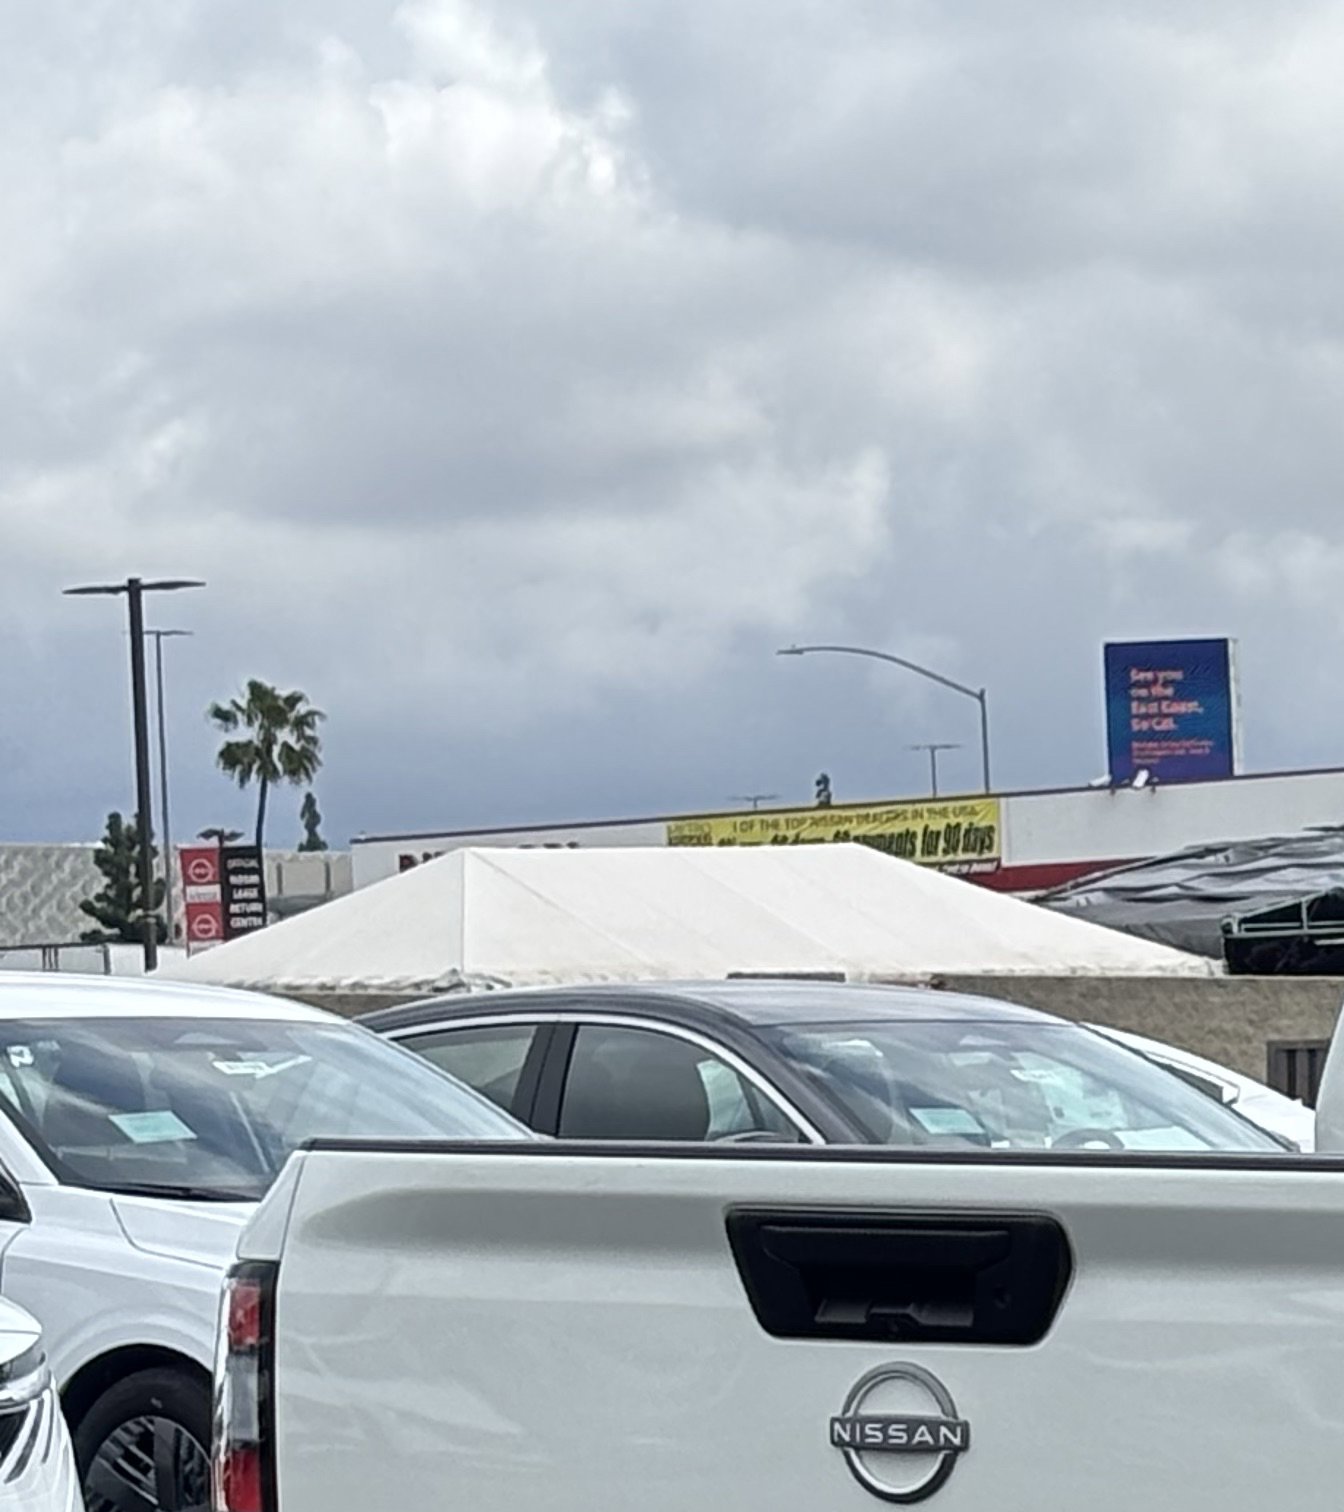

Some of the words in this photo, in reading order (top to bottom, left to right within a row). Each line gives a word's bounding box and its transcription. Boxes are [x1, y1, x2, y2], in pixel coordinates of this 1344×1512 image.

[921, 823, 941, 857] for
[962, 821, 996, 856] days
[833, 1421, 962, 1446] NISSAN
